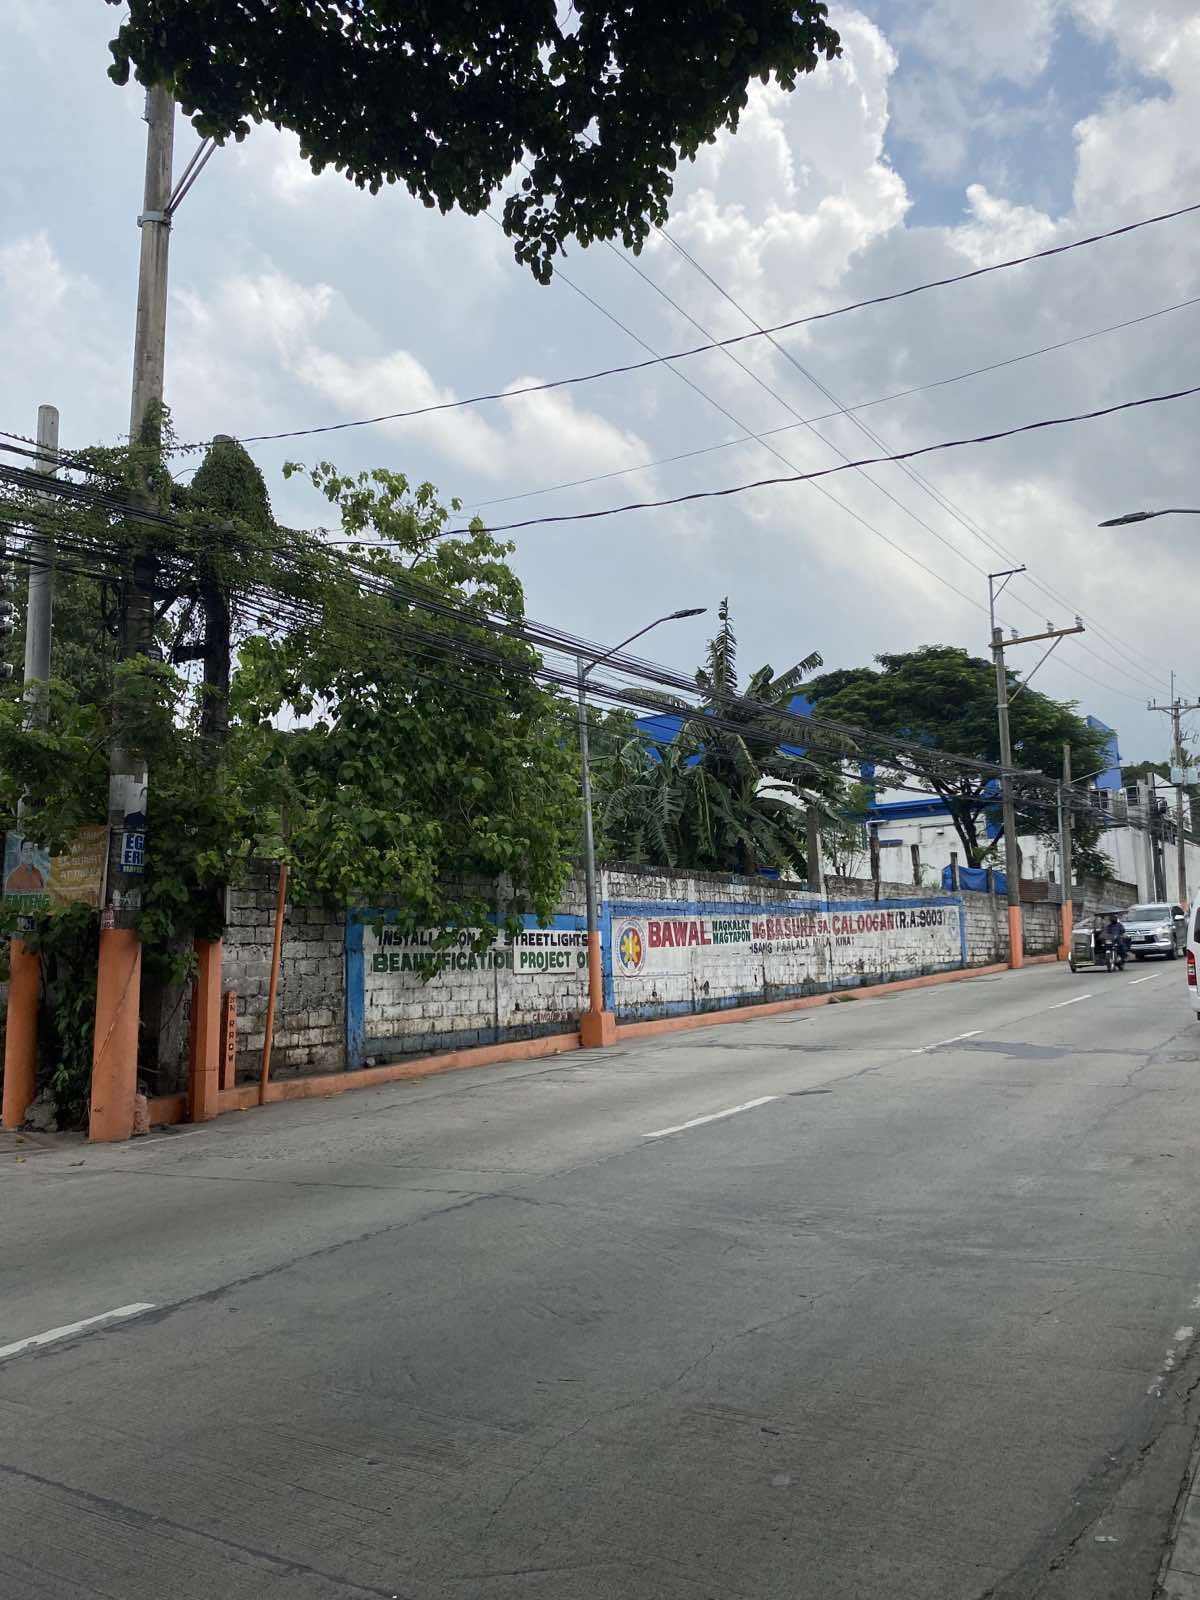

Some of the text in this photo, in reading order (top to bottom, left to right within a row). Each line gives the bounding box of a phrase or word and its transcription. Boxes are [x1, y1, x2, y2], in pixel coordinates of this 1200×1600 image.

[648, 920, 712, 948] BAWAL
[752, 921, 766, 939] NG
[520, 951, 571, 971] PROJECT
[576, 951, 588, 968] O
